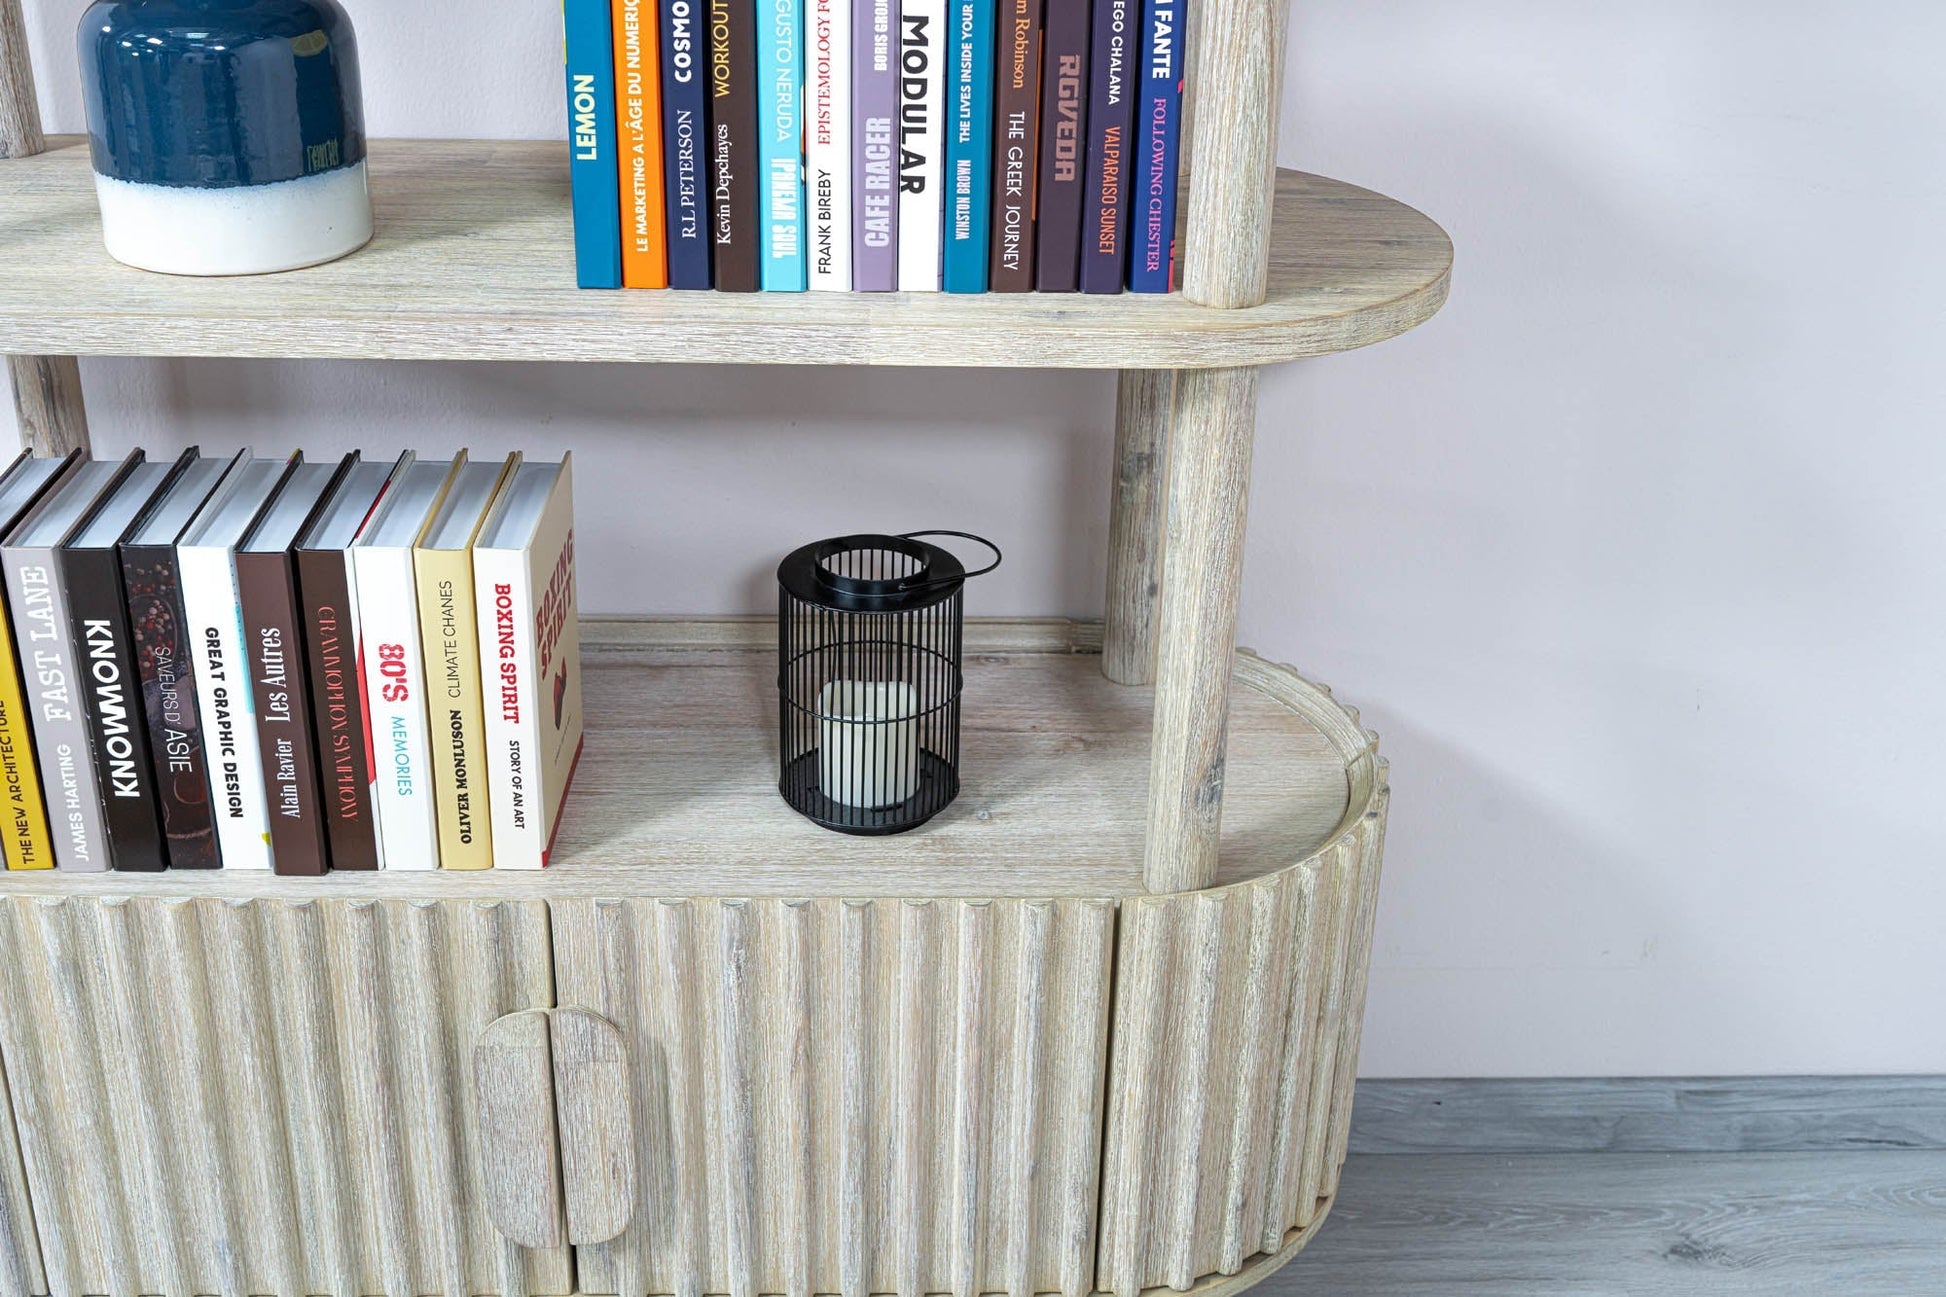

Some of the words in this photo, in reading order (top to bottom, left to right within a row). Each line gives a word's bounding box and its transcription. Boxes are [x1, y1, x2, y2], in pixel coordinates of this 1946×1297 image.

[672, 1, 691, 83] COSMO
[962, 5, 974, 40] YOUR
[1112, 1, 1124, 32] EGO
[1152, 10, 1173, 79] FANTE
[713, 0, 731, 97] WORKOUT
[874, 33, 888, 71] BORIS
[961, 42, 972, 83] INSIDE
[1013, 18, 1030, 88] Robinson
[1108, 36, 1123, 105] CHALANA
[627, 72, 642, 93] DU
[776, 69, 793, 142] NERUDA
[817, 17, 831, 145] EPISTEMOLOGY
[900, 15, 929, 195] MODULAR
[960, 84, 971, 120] LIVES
[573, 74, 597, 161] LEMON
[625, 98, 644, 141] L'ÂGE
[959, 121, 970, 143] THE
[1008, 111, 1024, 140] THE
[1054, 54, 1081, 182] RGVEDA
[632, 143, 644, 154] A
[677, 110, 695, 207] PETERSON
[715, 124, 734, 201] Depchayes
[866, 117, 891, 189] RACER
[1006, 147, 1023, 196] GREEK
[1101, 126, 1121, 204] VALPARAISO
[1150, 98, 1167, 196] FOLLOWING
[630, 157, 648, 236] MARKETING
[771, 158, 797, 221] IPANEMA
[818, 169, 831, 220] BIREBY
[957, 160, 971, 194] BROWN
[637, 237, 648, 252] LE
[716, 205, 731, 244] Kevin
[772, 224, 797, 258] SOUL
[865, 196, 889, 247] CAFE
[955, 195, 971, 240] WINSTON
[1003, 205, 1020, 270] JOURNEY
[1099, 207, 1117, 255] SUNSET
[1146, 199, 1163, 272] CHESTER
[818, 225, 831, 274] FRANK
[19, 566, 59, 642] LANE
[439, 580, 456, 636] CHANES
[536, 529, 573, 649] BOXING
[495, 583, 515, 659] BOXING
[541, 573, 573, 681] SPIRIT
[154, 646, 179, 711] SAVEURS
[204, 627, 224, 681] GREAT
[260, 627, 287, 688] Autres
[378, 643, 409, 703] 80'S
[442, 640, 461, 698] CLIMATE
[30, 651, 72, 722] FAST
[265, 692, 290, 723] Les
[499, 662, 519, 724] SPIRIT
[213, 687, 235, 757] GRAPHIC
[449, 709, 467, 789] MONLUSON
[57, 744, 82, 810] HARTING
[163, 728, 193, 773] ASIE
[276, 738, 296, 783] Ravier
[332, 734, 358, 823] SYMPHONY
[391, 716, 412, 796] MEMORIES
[509, 740, 521, 774] STORY
[223, 763, 244, 818] DESIGN
[281, 786, 301, 818] Alain
[511, 776, 522, 790] OF
[513, 791, 523, 807] AN
[13, 806, 31, 836] NEW
[67, 811, 90, 861] JAMES
[457, 792, 472, 844] OLIVER
[514, 809, 525, 829] ART
[20, 840, 34, 864] THE
